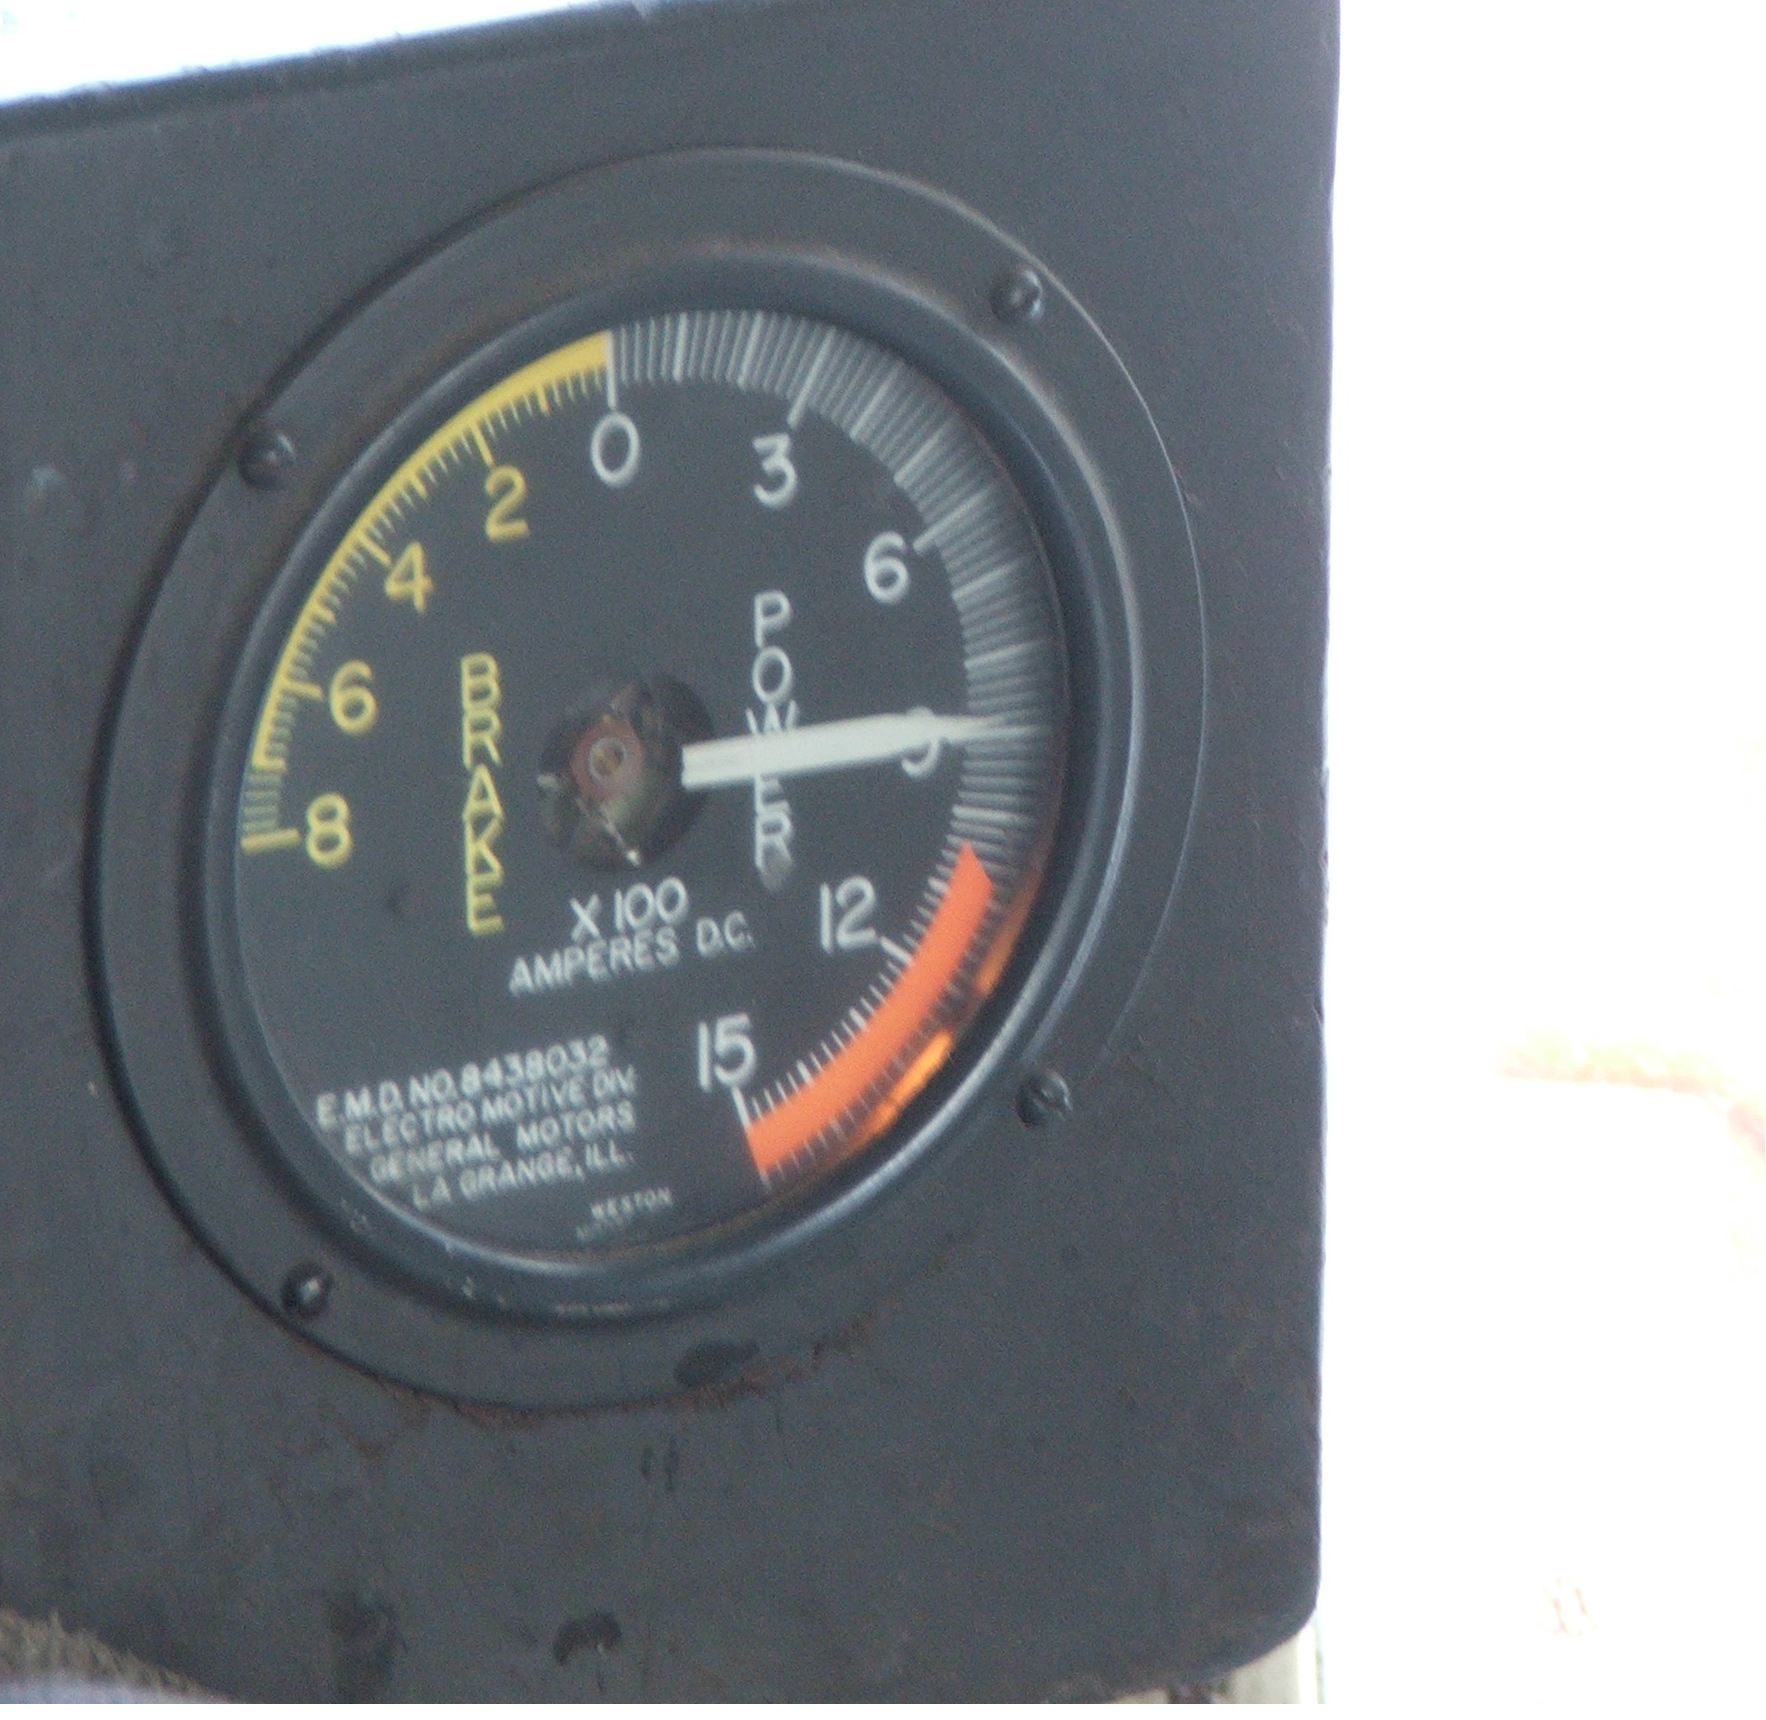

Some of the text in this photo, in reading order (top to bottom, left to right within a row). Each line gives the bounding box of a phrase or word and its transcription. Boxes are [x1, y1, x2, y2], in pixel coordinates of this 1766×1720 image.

[591, 411, 640, 487] 0
[752, 432, 797, 508] 3
[484, 464, 530, 541] 2
[384, 540, 434, 615] 4
[863, 531, 909, 605] 6
[328, 659, 379, 735] 6
[305, 792, 353, 871] 8
[460, 652, 503, 937] BRAKE
[569, 877, 688, 942] X 100
[819, 874, 881, 953] 12
[508, 926, 680, 996] AMPERES
[697, 1014, 755, 1091] 15
[345, 1101, 476, 1158] ELECTRO
[480, 1076, 586, 1127] MOTIVE
[369, 1099, 637, 1185] GENERAL MOTORS
[412, 1175, 451, 1212] LA
